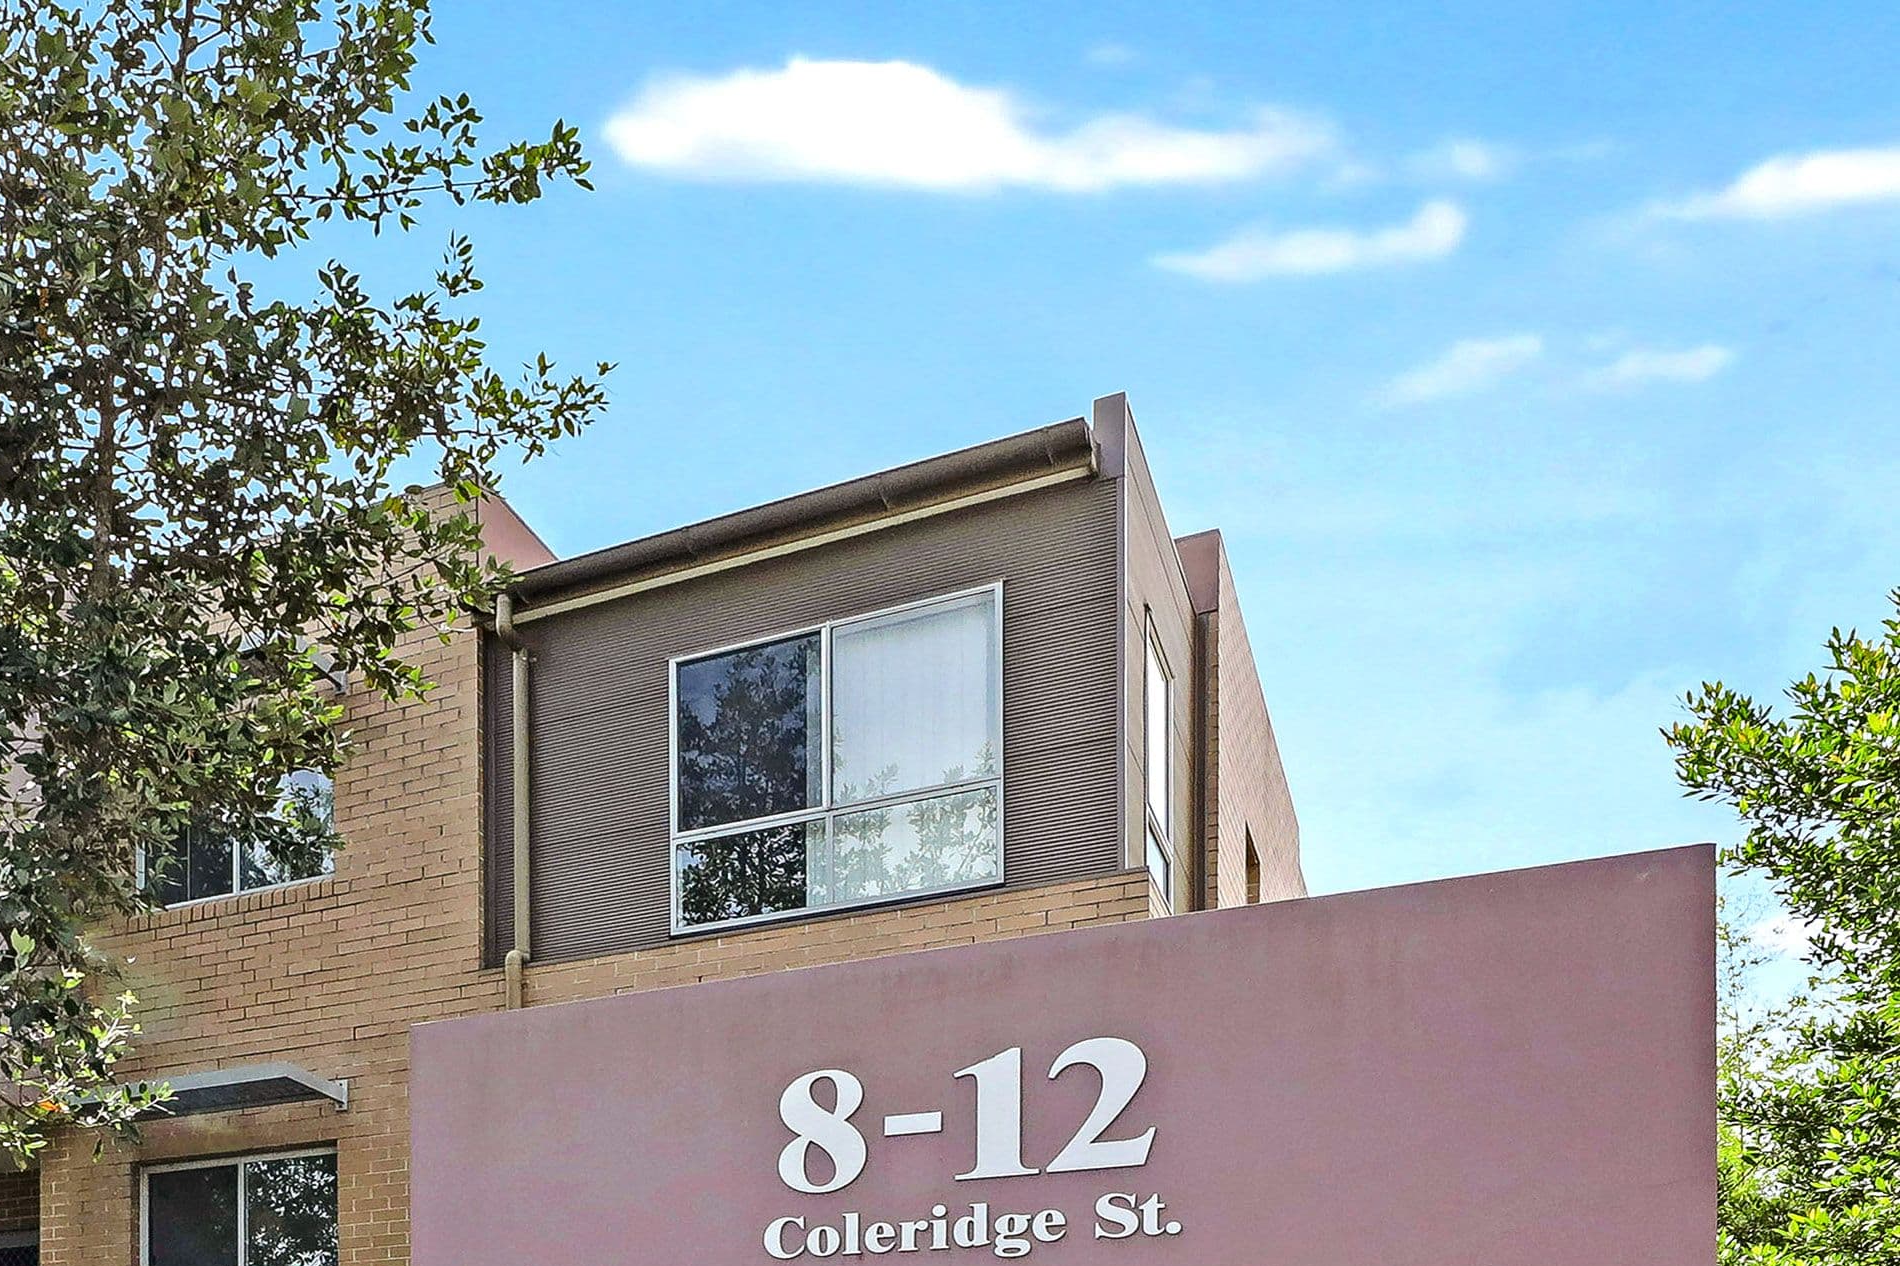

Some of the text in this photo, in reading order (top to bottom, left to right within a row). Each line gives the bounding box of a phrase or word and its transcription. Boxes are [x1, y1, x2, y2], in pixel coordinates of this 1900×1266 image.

[777, 1036, 1157, 1194] 8-12
[762, 1192, 1183, 1260] Coleridge St.
